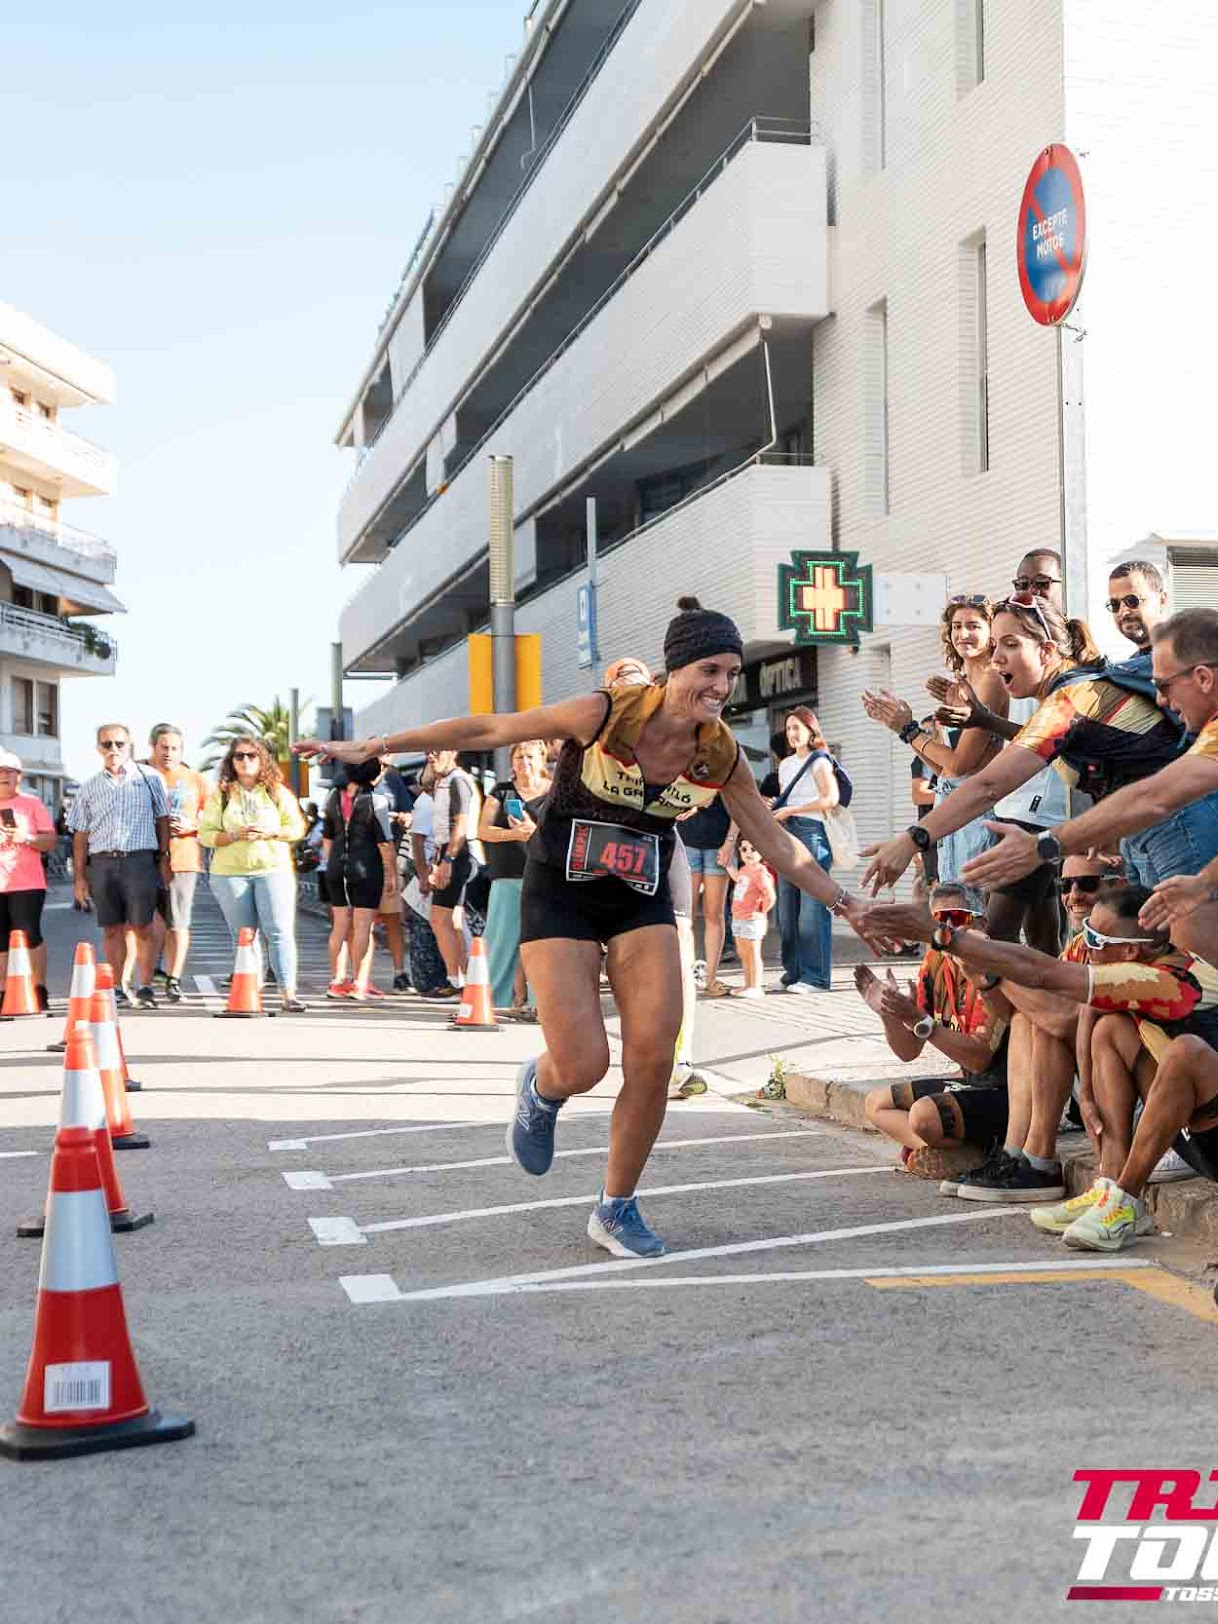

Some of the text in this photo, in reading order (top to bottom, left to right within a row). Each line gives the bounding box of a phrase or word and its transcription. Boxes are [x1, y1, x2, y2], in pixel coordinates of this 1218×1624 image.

[1032, 208, 1068, 241] EXCEPTE
[1036, 232, 1064, 258] MOTOS
[600, 842, 648, 874] 457
